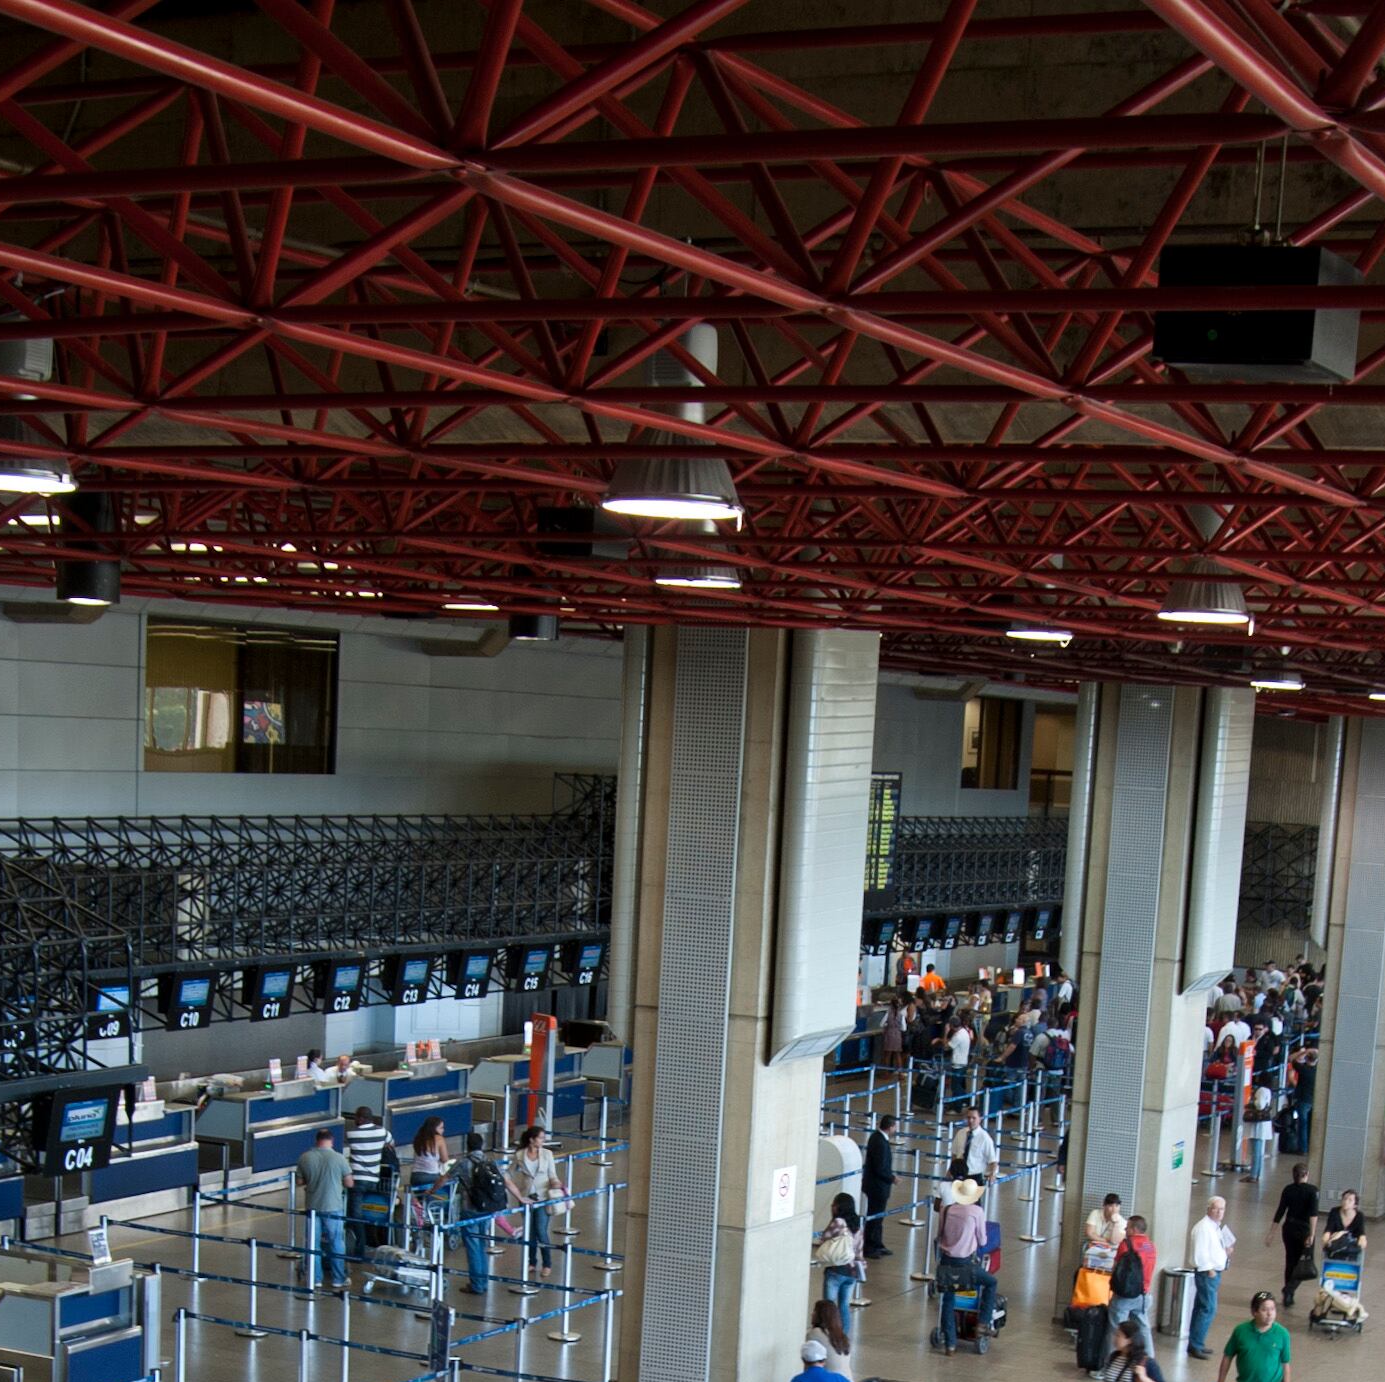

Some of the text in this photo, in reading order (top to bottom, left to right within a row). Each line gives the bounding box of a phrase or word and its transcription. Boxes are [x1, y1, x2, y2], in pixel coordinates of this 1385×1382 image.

[464, 983, 480, 998] C14
[524, 976, 539, 991] C15
[333, 996, 351, 1011] C12
[402, 989, 419, 1004] C13
[262, 1002, 281, 1019] C11
[179, 1011, 201, 1028] C10
[64, 1146, 94, 1171] C04
